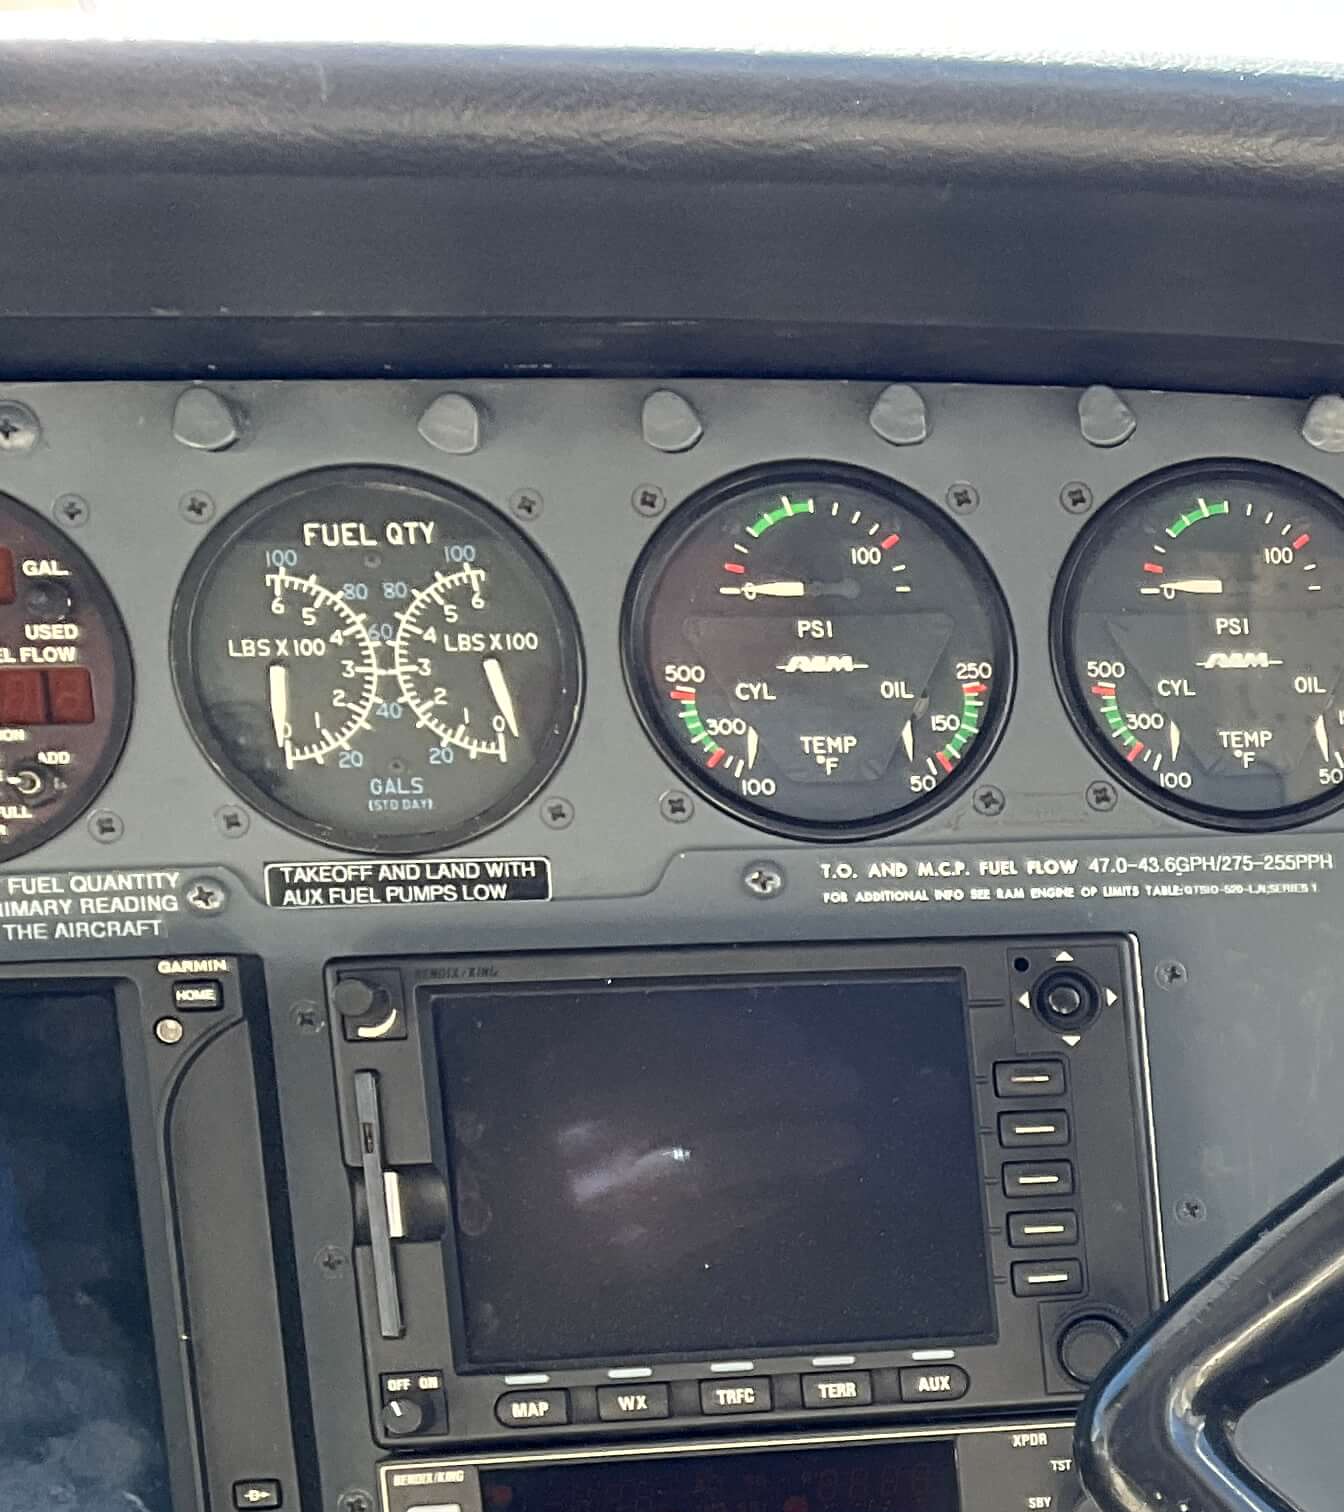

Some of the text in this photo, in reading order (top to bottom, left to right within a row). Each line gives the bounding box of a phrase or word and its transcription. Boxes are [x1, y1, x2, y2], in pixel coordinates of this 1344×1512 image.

[304, 522, 435, 546] FUEL QTY
[25, 624, 79, 640] USED
[798, 620, 833, 638] PSI
[1216, 618, 1249, 634] PSI
[21, 647, 77, 662] FLOW
[735, 683, 776, 700] CYL
[881, 682, 914, 699] OIL
[1157, 680, 1195, 696] CYL
[1294, 677, 1326, 693] OIL
[800, 736, 857, 754] TEMP
[1219, 731, 1272, 748] TEMP
[38, 751, 70, 764] ADD
[370, 778, 423, 795] GALS
[280, 862, 535, 883] TAKEOFF AND LAND WITH
[821, 864, 858, 879] T.O.
[868, 863, 907, 878] AND
[918, 861, 970, 877] M.C.P.
[979, 861, 1017, 876] FUEL
[1027, 859, 1078, 875] FLOW
[8, 872, 179, 894] FUEL QUANTITY
[283, 884, 508, 905] AUX FUEL PUMPS LOW
[823, 891, 848, 903] FOR
[855, 889, 929, 902] ADDITIONAL
[80, 898, 179, 915] READING
[3, 919, 162, 940] THE AIRCRAFT
[158, 960, 227, 973] GARMIN
[176, 989, 216, 1001] HOME
[388, 1377, 438, 1391] OFF ON
[818, 1382, 856, 1400] TERR
[918, 1376, 950, 1392] AUX
[618, 1396, 647, 1411] WX
[717, 1389, 754, 1405] TRFC
[512, 1402, 549, 1418] MAP
[1012, 1433, 1048, 1447] XPDR
[1050, 1460, 1072, 1471] TST
[1028, 1497, 1051, 1509] SBY
